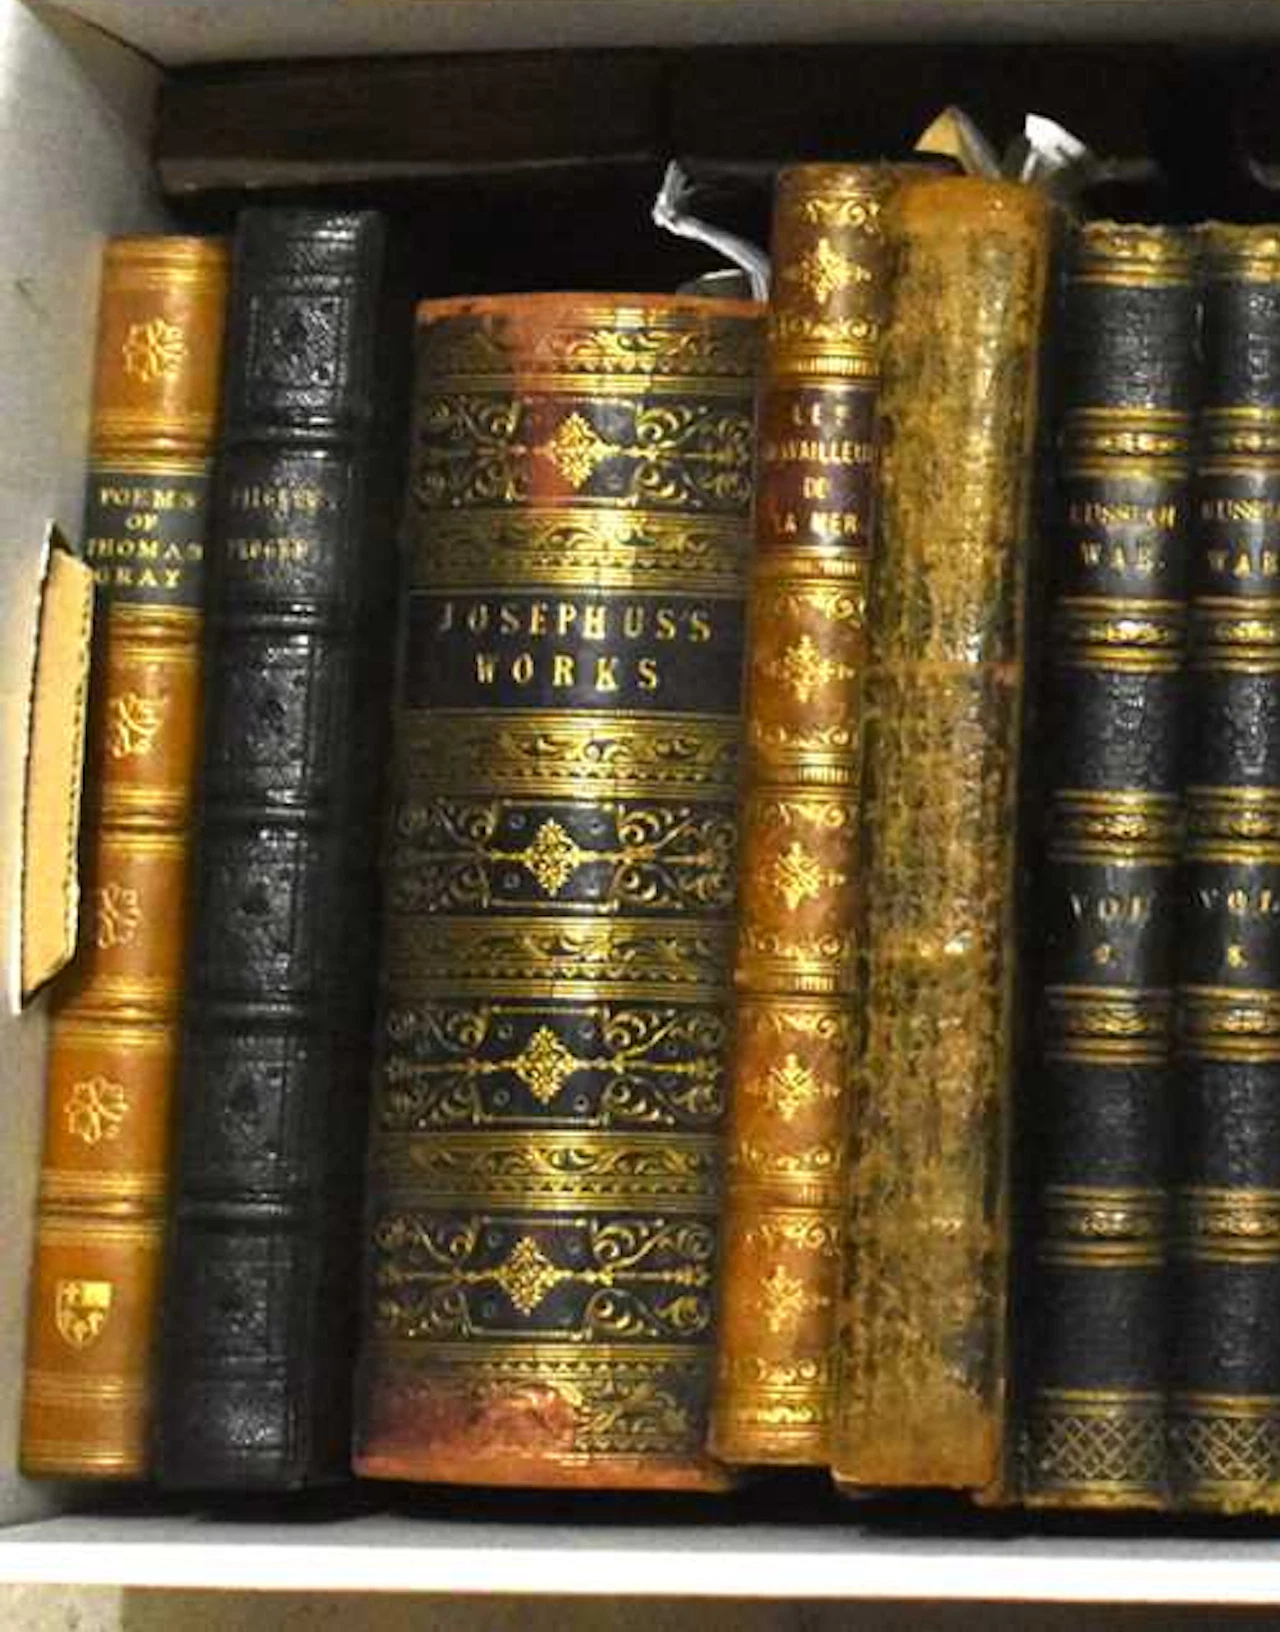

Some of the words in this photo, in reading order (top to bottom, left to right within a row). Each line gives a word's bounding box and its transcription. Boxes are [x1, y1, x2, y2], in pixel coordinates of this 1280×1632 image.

[99, 486, 198, 510] POEMS
[802, 475, 831, 500] DE
[124, 512, 159, 533] OF
[809, 510, 859, 537] MER
[87, 537, 205, 562] THOMAS
[94, 565, 182, 590] GRAY
[474, 651, 660, 692] WORKS
